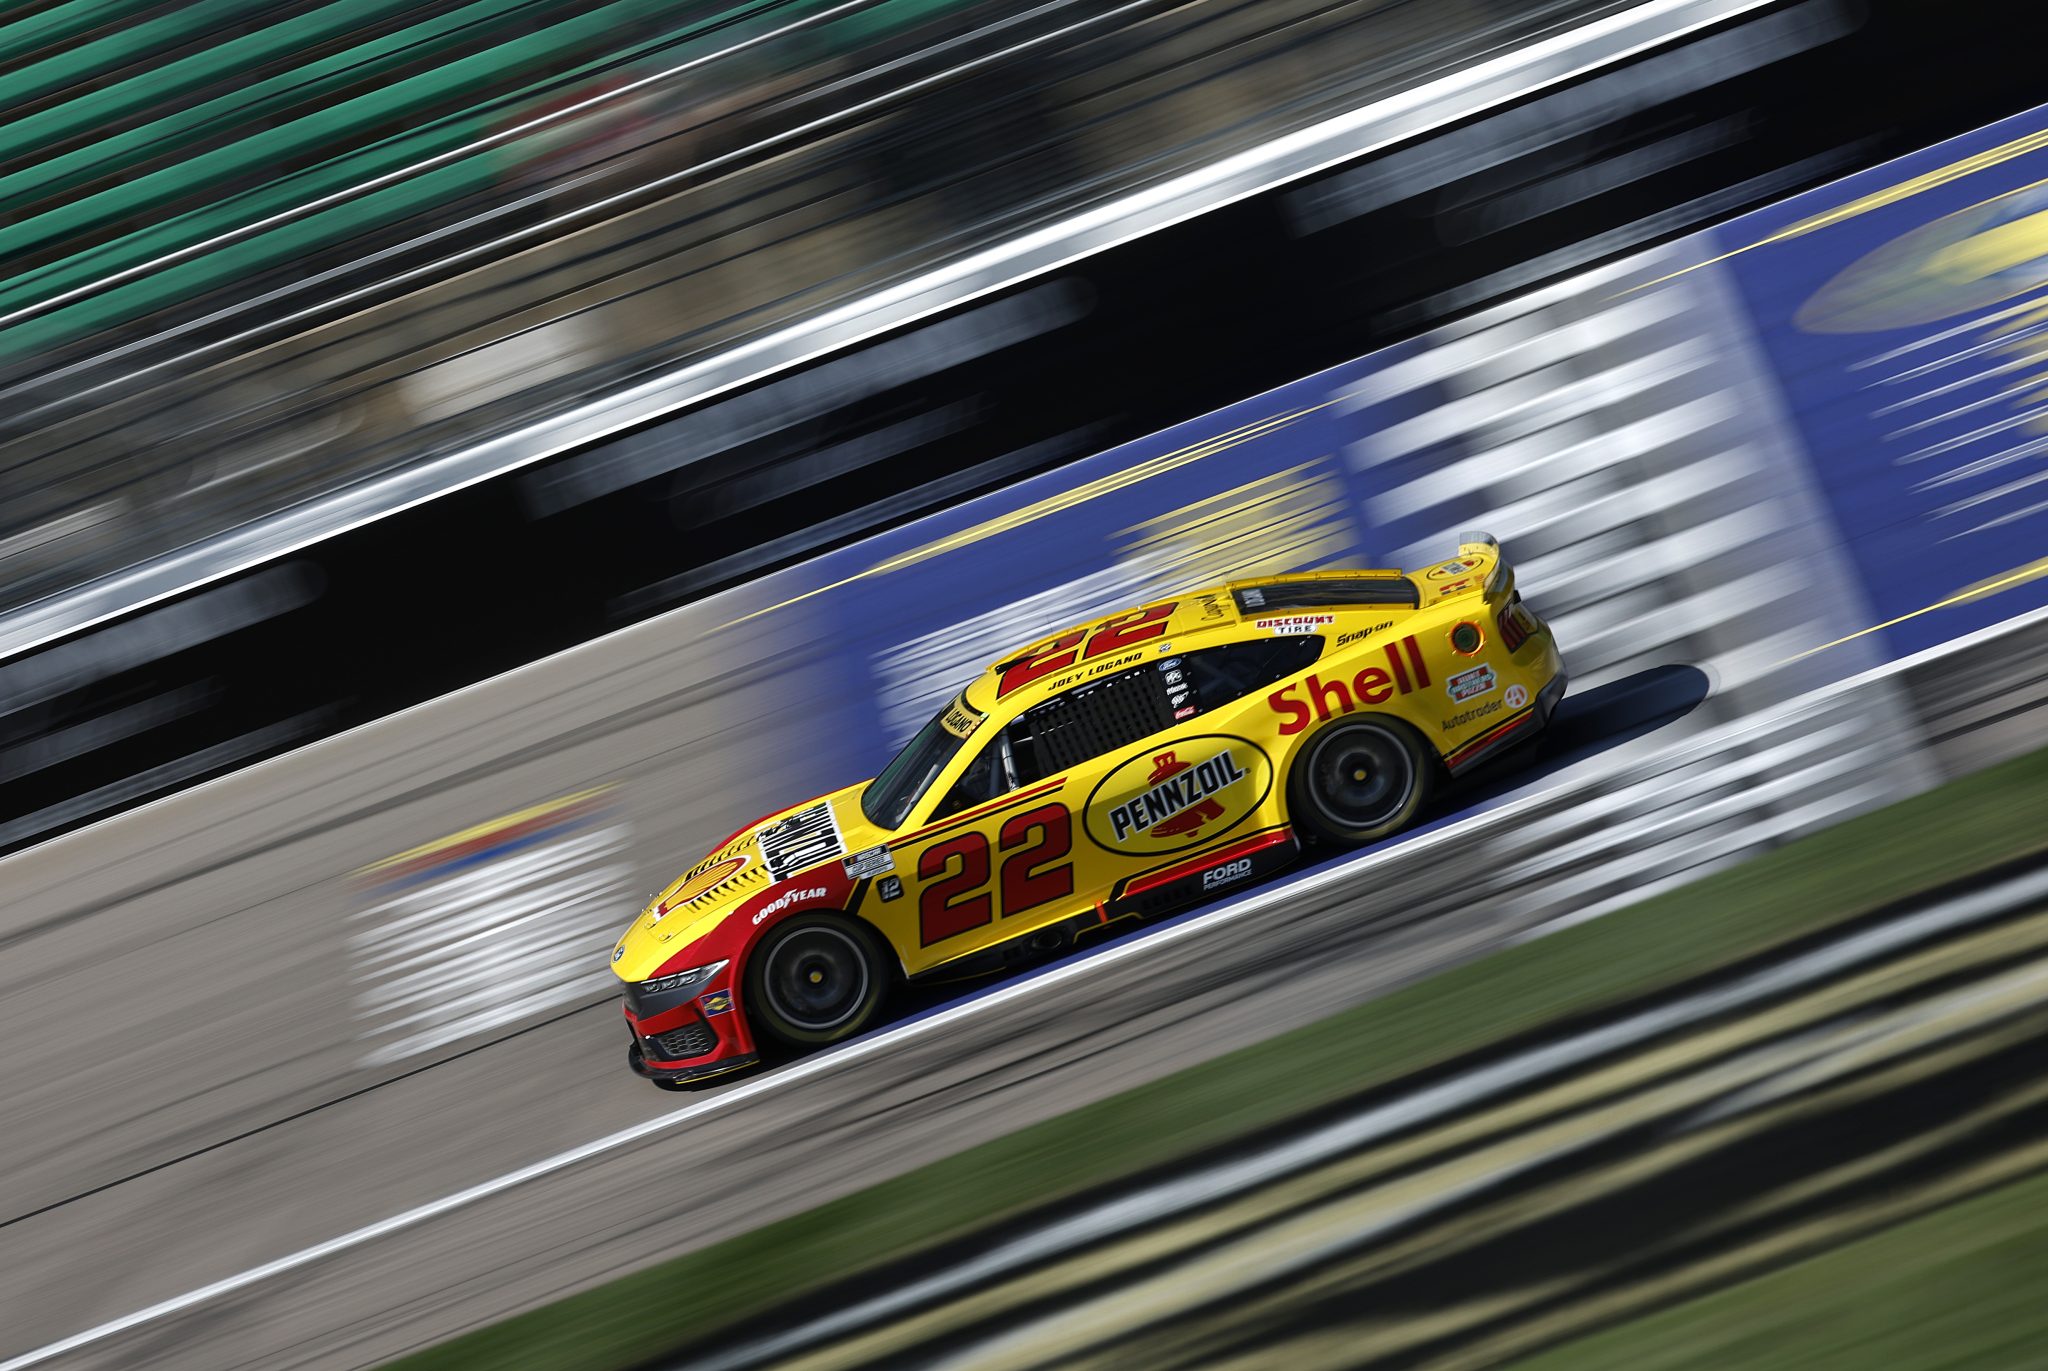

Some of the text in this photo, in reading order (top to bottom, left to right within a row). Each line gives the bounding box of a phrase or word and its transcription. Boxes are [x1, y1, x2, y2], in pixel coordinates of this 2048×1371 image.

[1256, 615, 1335, 629] DISCOUNT
[1278, 624, 1314, 634] TIRE
[1336, 620, 1394, 648] Snap-on
[996, 602, 1180, 700] 22
[1048, 652, 1143, 691] JOEY LOGANO
[1267, 635, 1432, 736] Shell
[1442, 699, 1503, 731] Autotrader
[1108, 749, 1245, 843] PENNZOIL
[917, 801, 1074, 949] 22
[1203, 858, 1251, 884] FORD
[1203, 870, 1252, 890] PERFORMANCE
[752, 887, 827, 925] GOODYEAR
